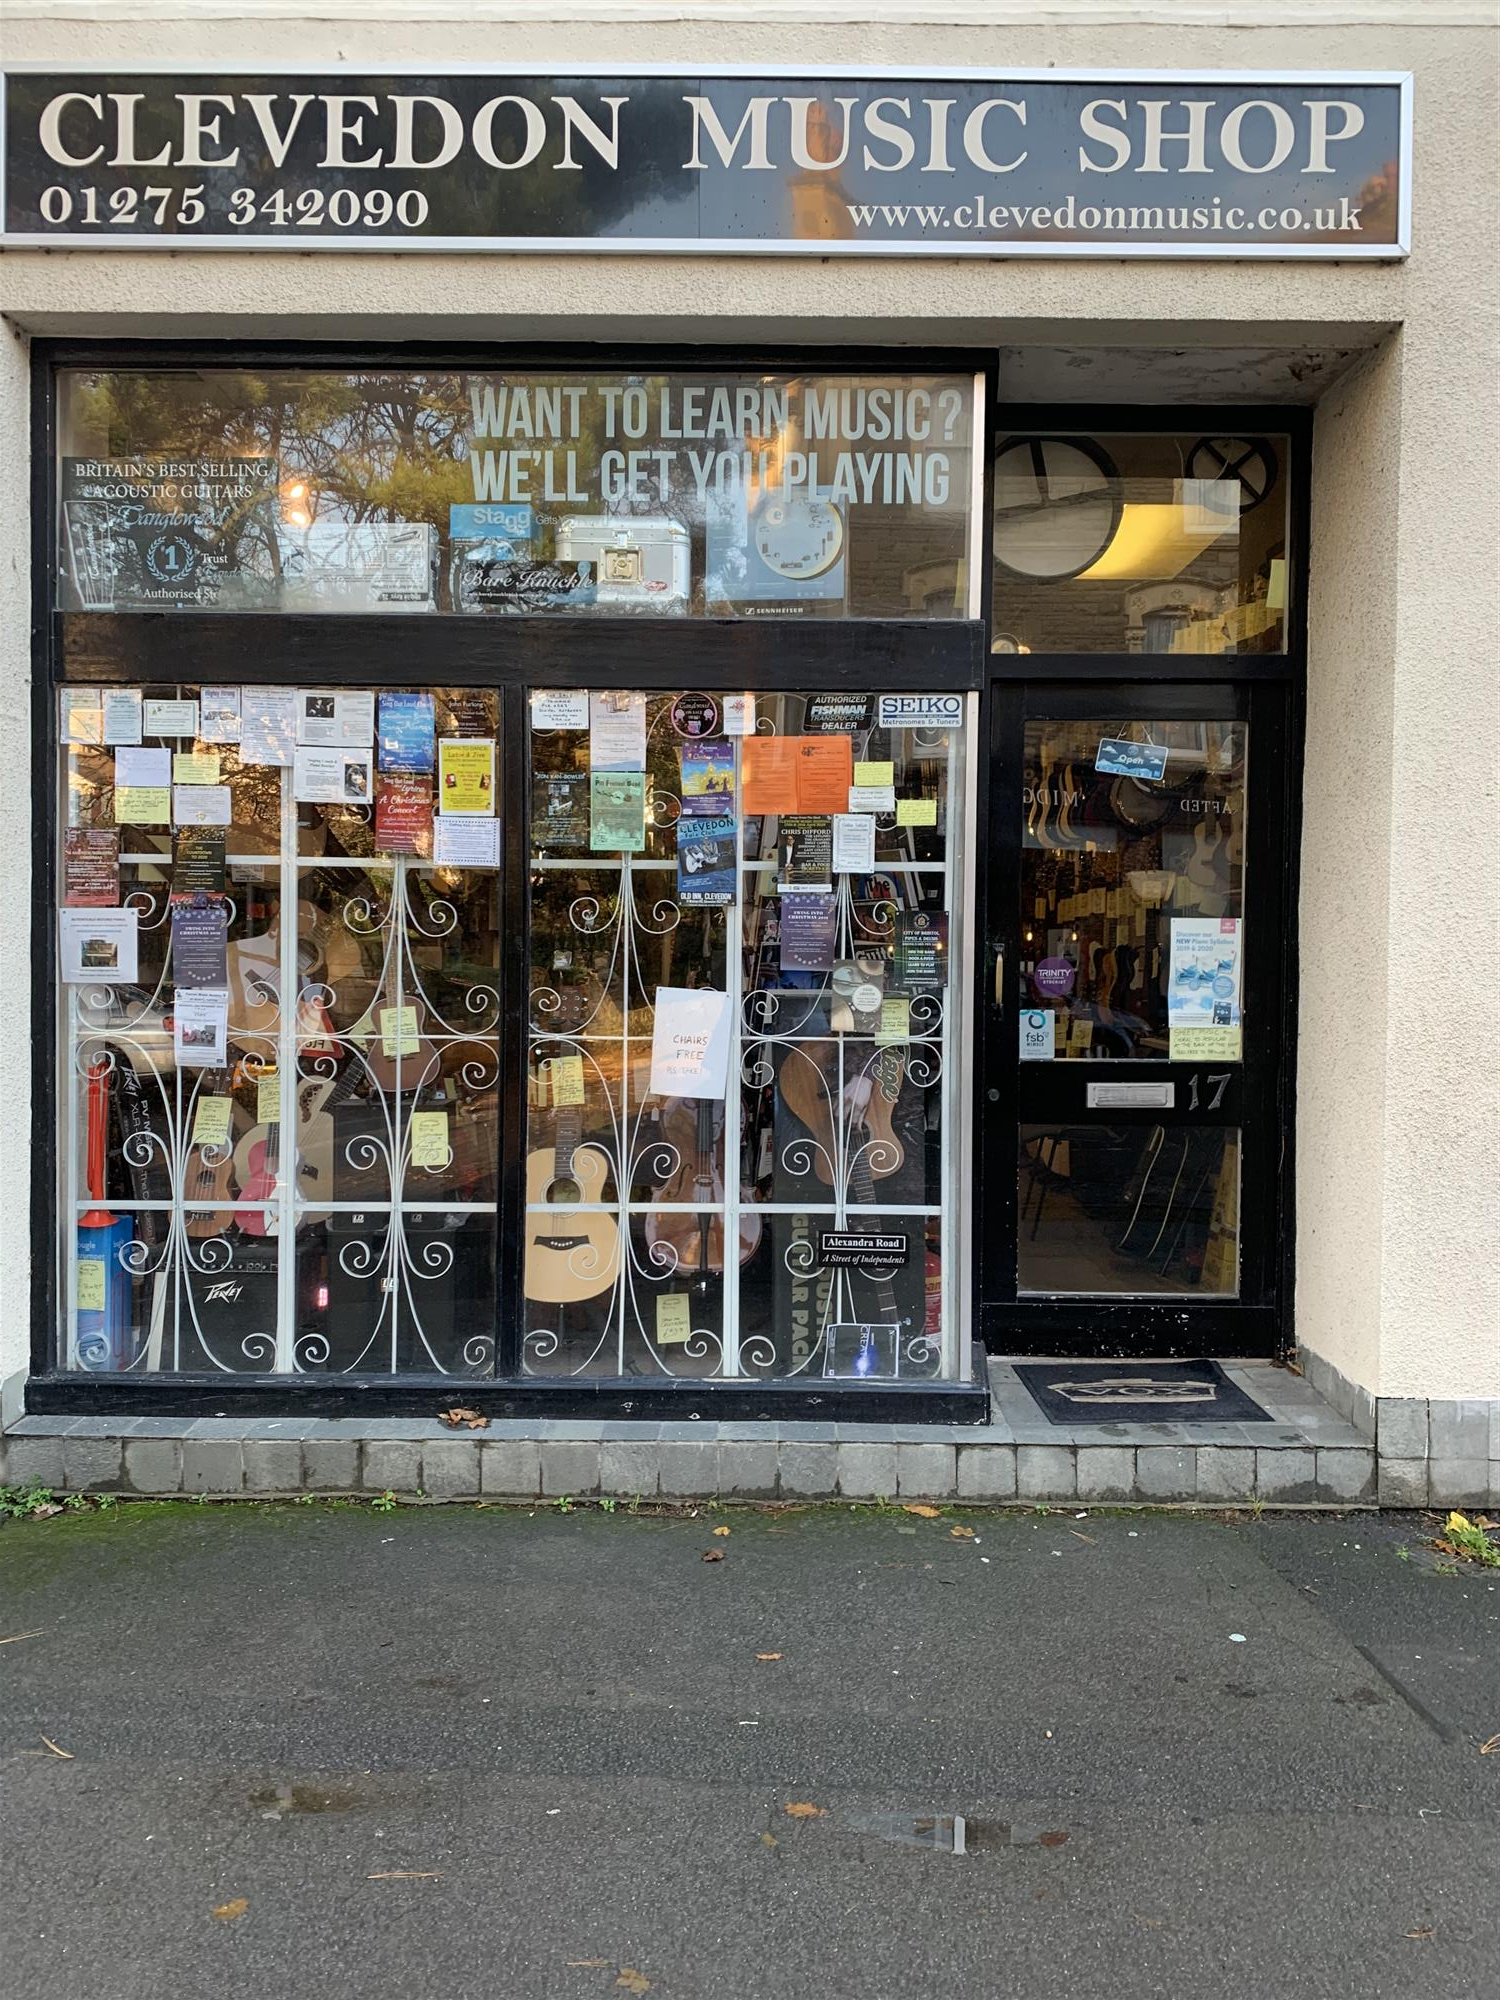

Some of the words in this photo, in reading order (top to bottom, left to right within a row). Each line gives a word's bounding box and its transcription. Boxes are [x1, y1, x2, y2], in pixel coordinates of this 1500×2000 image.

[38, 91, 630, 170] CLEVEDON
[682, 95, 1028, 174] MUSIC
[1077, 98, 1366, 174] SHOP
[39, 184, 206, 226] 01275
[227, 186, 430, 227] 342090
[846, 196, 1364, 231] www.clevedonmusic.co.uk
[470, 386, 587, 439] WANT
[598, 386, 649, 440] TO
[660, 387, 790, 440] LEARN
[803, 388, 963, 442] MUSIC?
[75, 463, 155, 478] BRITAIN'S
[159, 464, 200, 477] BEST
[201, 464, 269, 478] SELLING
[470, 449, 589, 502] WE'LL
[601, 450, 677, 502] GET
[688, 450, 766, 503] YOU
[784, 451, 951, 505] PLAYING
[91, 484, 178, 498] ACOUSTIC
[180, 484, 253, 499] GUITARS
[473, 507, 531, 534] Stagg
[201, 552, 229, 564] Trust
[461, 570, 514, 587] Bare
[516, 570, 594, 588] Knuckle
[142, 587, 200, 600] Authorised
[814, 695, 867, 703] AUTHORIZED
[882, 697, 961, 713] SEIKO
[810, 704, 867, 715] FISHMAN
[821, 722, 858, 730] DEALER
[1119, 754, 1144, 765] Open
[390, 795, 431, 805] Christmas
[387, 804, 422, 815] Concert
[680, 818, 734, 833] CLEVEDON
[680, 892, 692, 900] OLD
[704, 892, 732, 900] CLEVEDON
[1037, 969, 1072, 977] TRINITY
[672, 1034, 709, 1046] CHAIRS
[1025, 1031, 1045, 1042] fsb
[676, 1048, 705, 1060] FREE
[1188, 1073, 1232, 1111] 17
[827, 1237, 874, 1247] Alexandra
[875, 1238, 900, 1248] Road
[791, 1214, 809, 1303] GUITAR
[822, 1254, 830, 1262] A
[831, 1254, 851, 1263] Street
[852, 1254, 861, 1265] of
[861, 1255, 906, 1266] Independents
[1081, 1386, 1199, 1396] VOX
